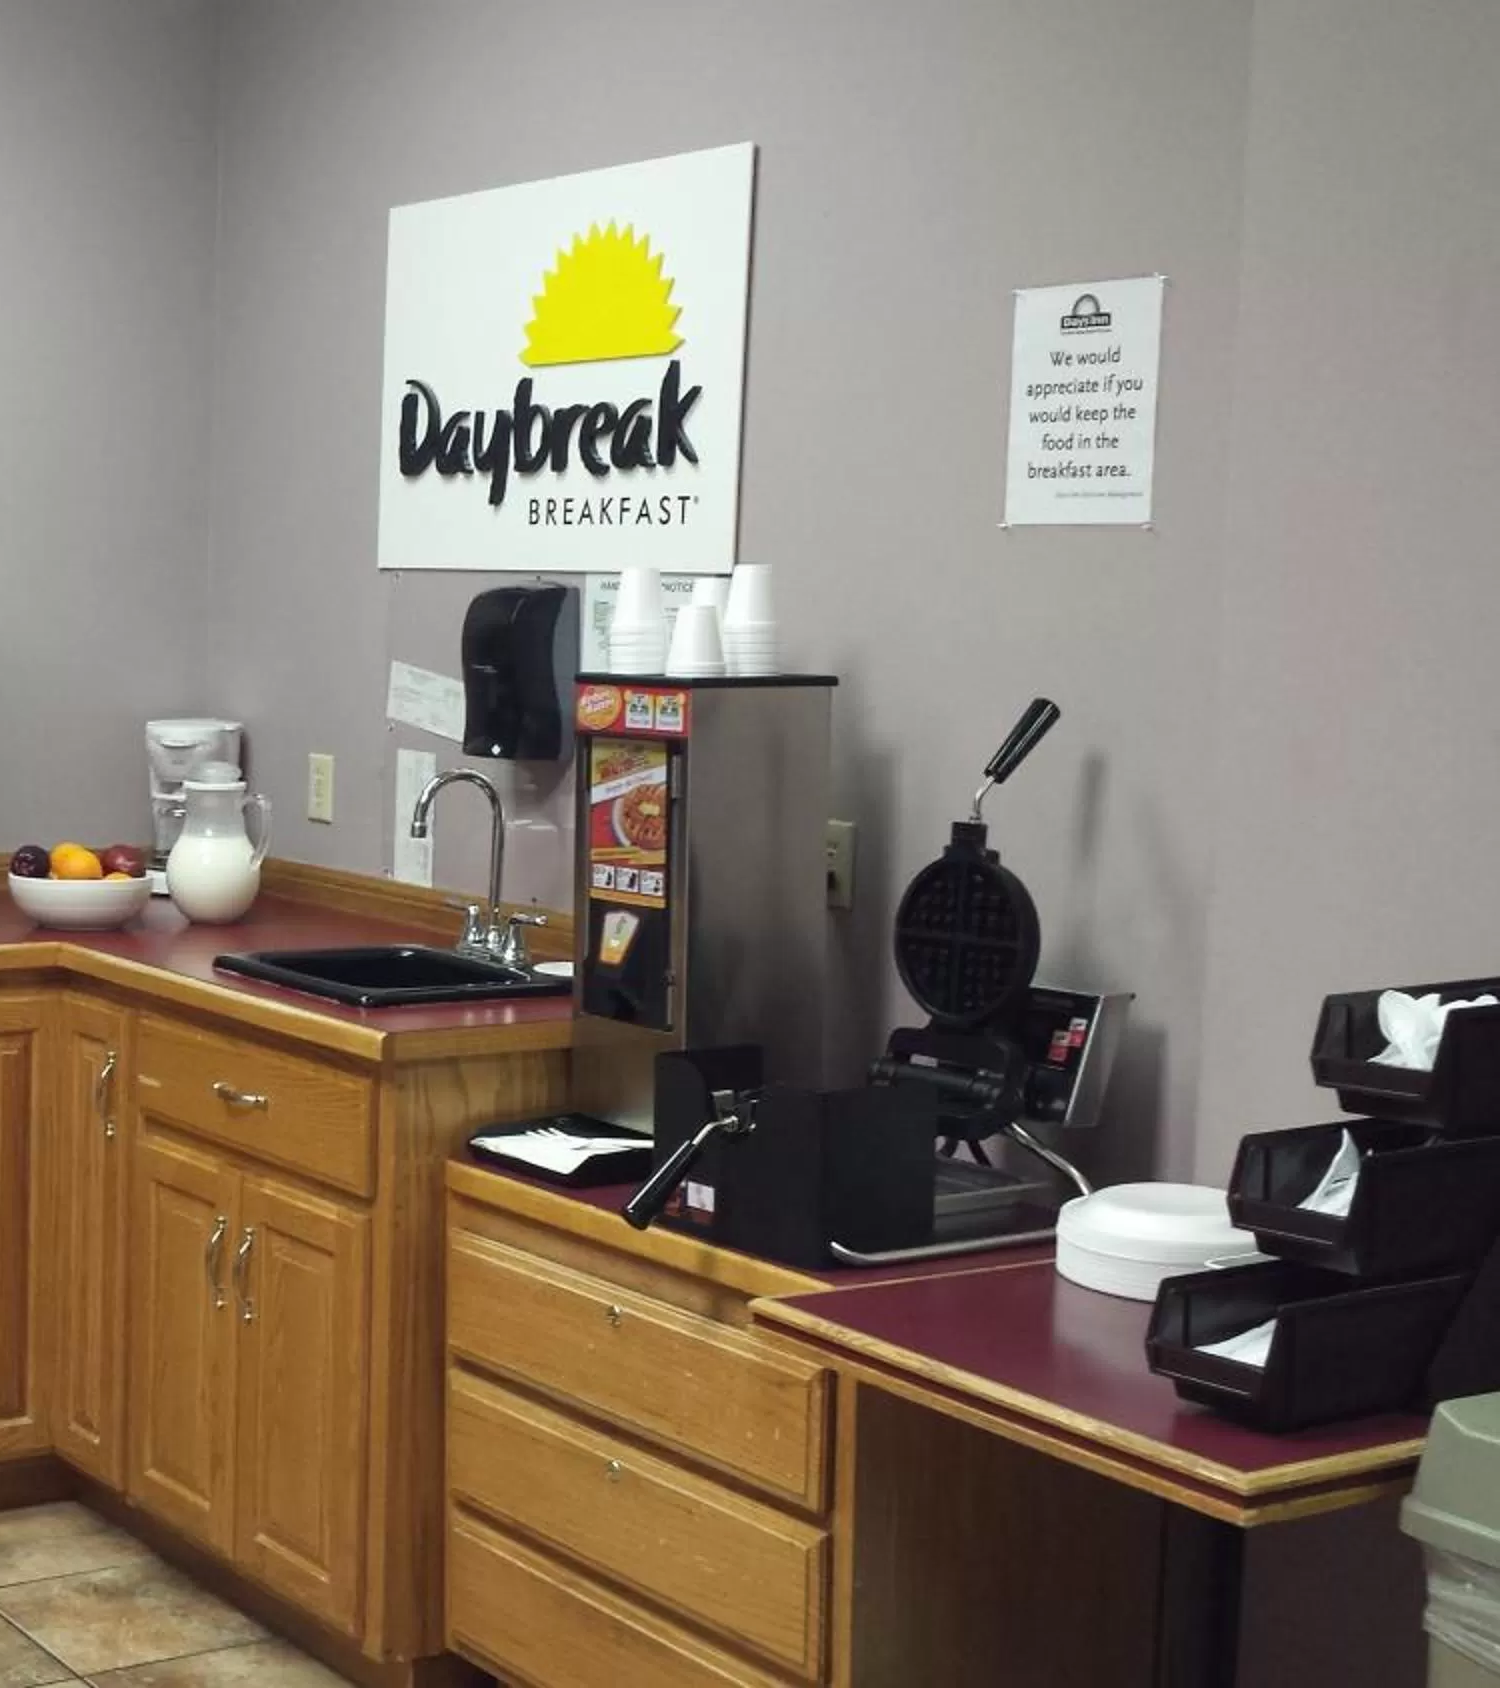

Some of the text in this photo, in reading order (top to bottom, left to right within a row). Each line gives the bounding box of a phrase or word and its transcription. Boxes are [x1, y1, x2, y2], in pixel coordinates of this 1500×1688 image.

[1049, 346, 1121, 366] We would
[1026, 374, 1144, 400] appreciate if you
[1029, 405, 1137, 425] would keep the
[398, 360, 703, 506] Daybreak
[1041, 433, 1120, 451] food in the
[1027, 462, 1132, 480] breakfast area.
[528, 497, 691, 525] BREAKFAST
